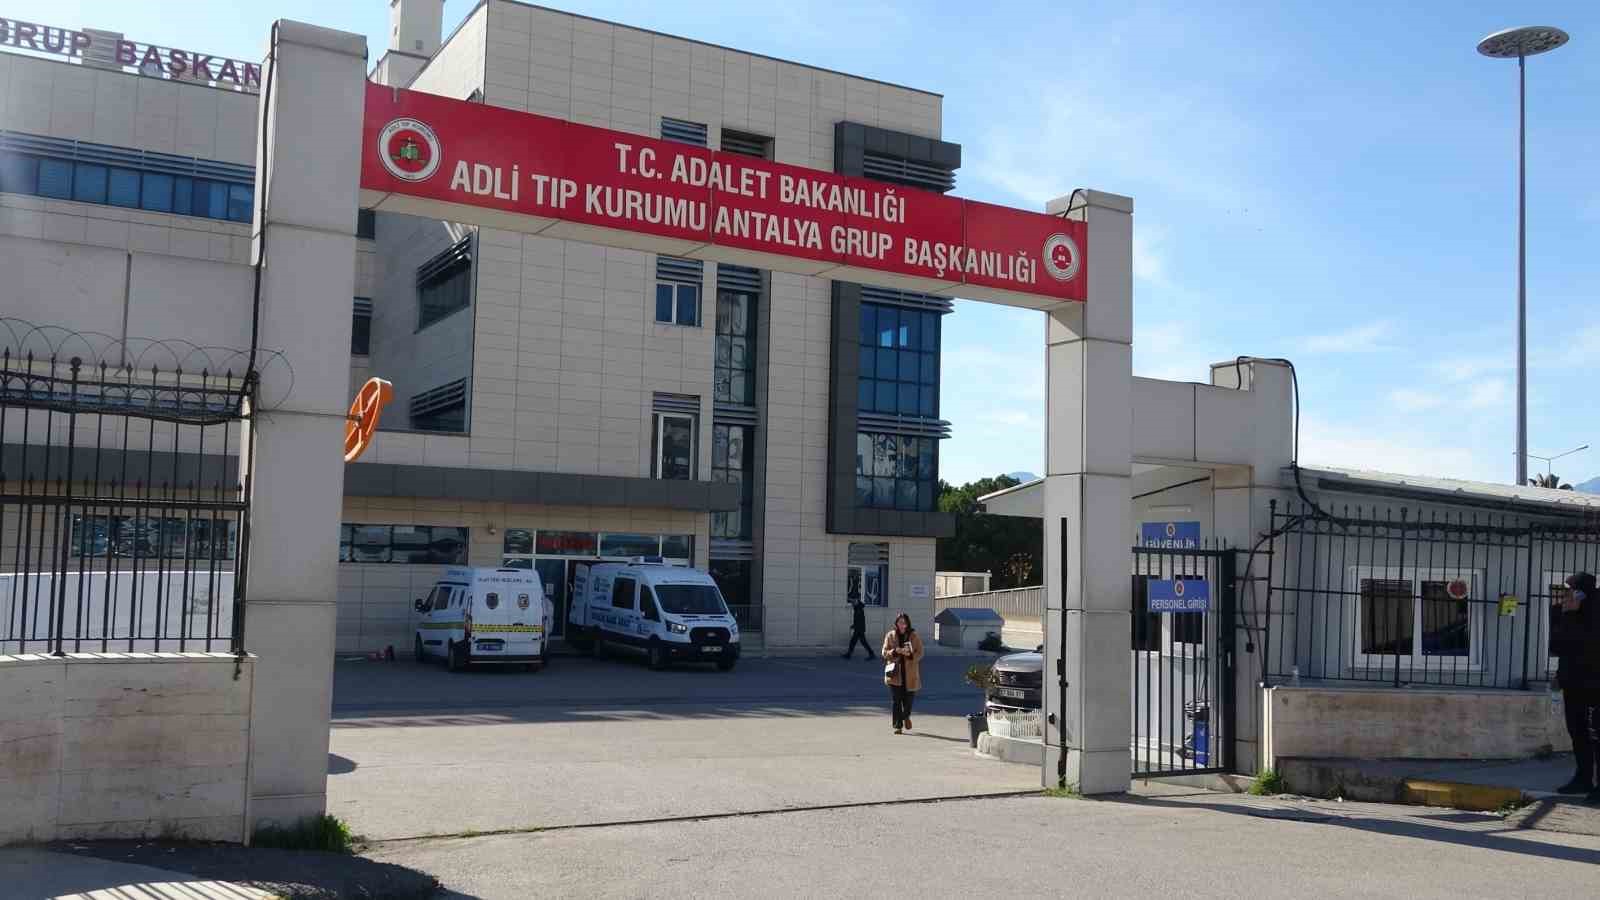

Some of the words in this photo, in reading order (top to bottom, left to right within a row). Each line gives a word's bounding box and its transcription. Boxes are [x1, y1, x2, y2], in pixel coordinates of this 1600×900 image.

[450, 159, 520, 201] ADLİ
[531, 174, 578, 211] TIP
[586, 183, 706, 233] KURUMU
[714, 206, 823, 251] ANTALYA
[830, 226, 893, 261] GRUP
[904, 238, 1037, 285] BAŞKANLIĞI
[614, 143, 663, 179] T.C.
[669, 155, 771, 200] ADALET
[780, 176, 906, 224] BAKANLIĞI
